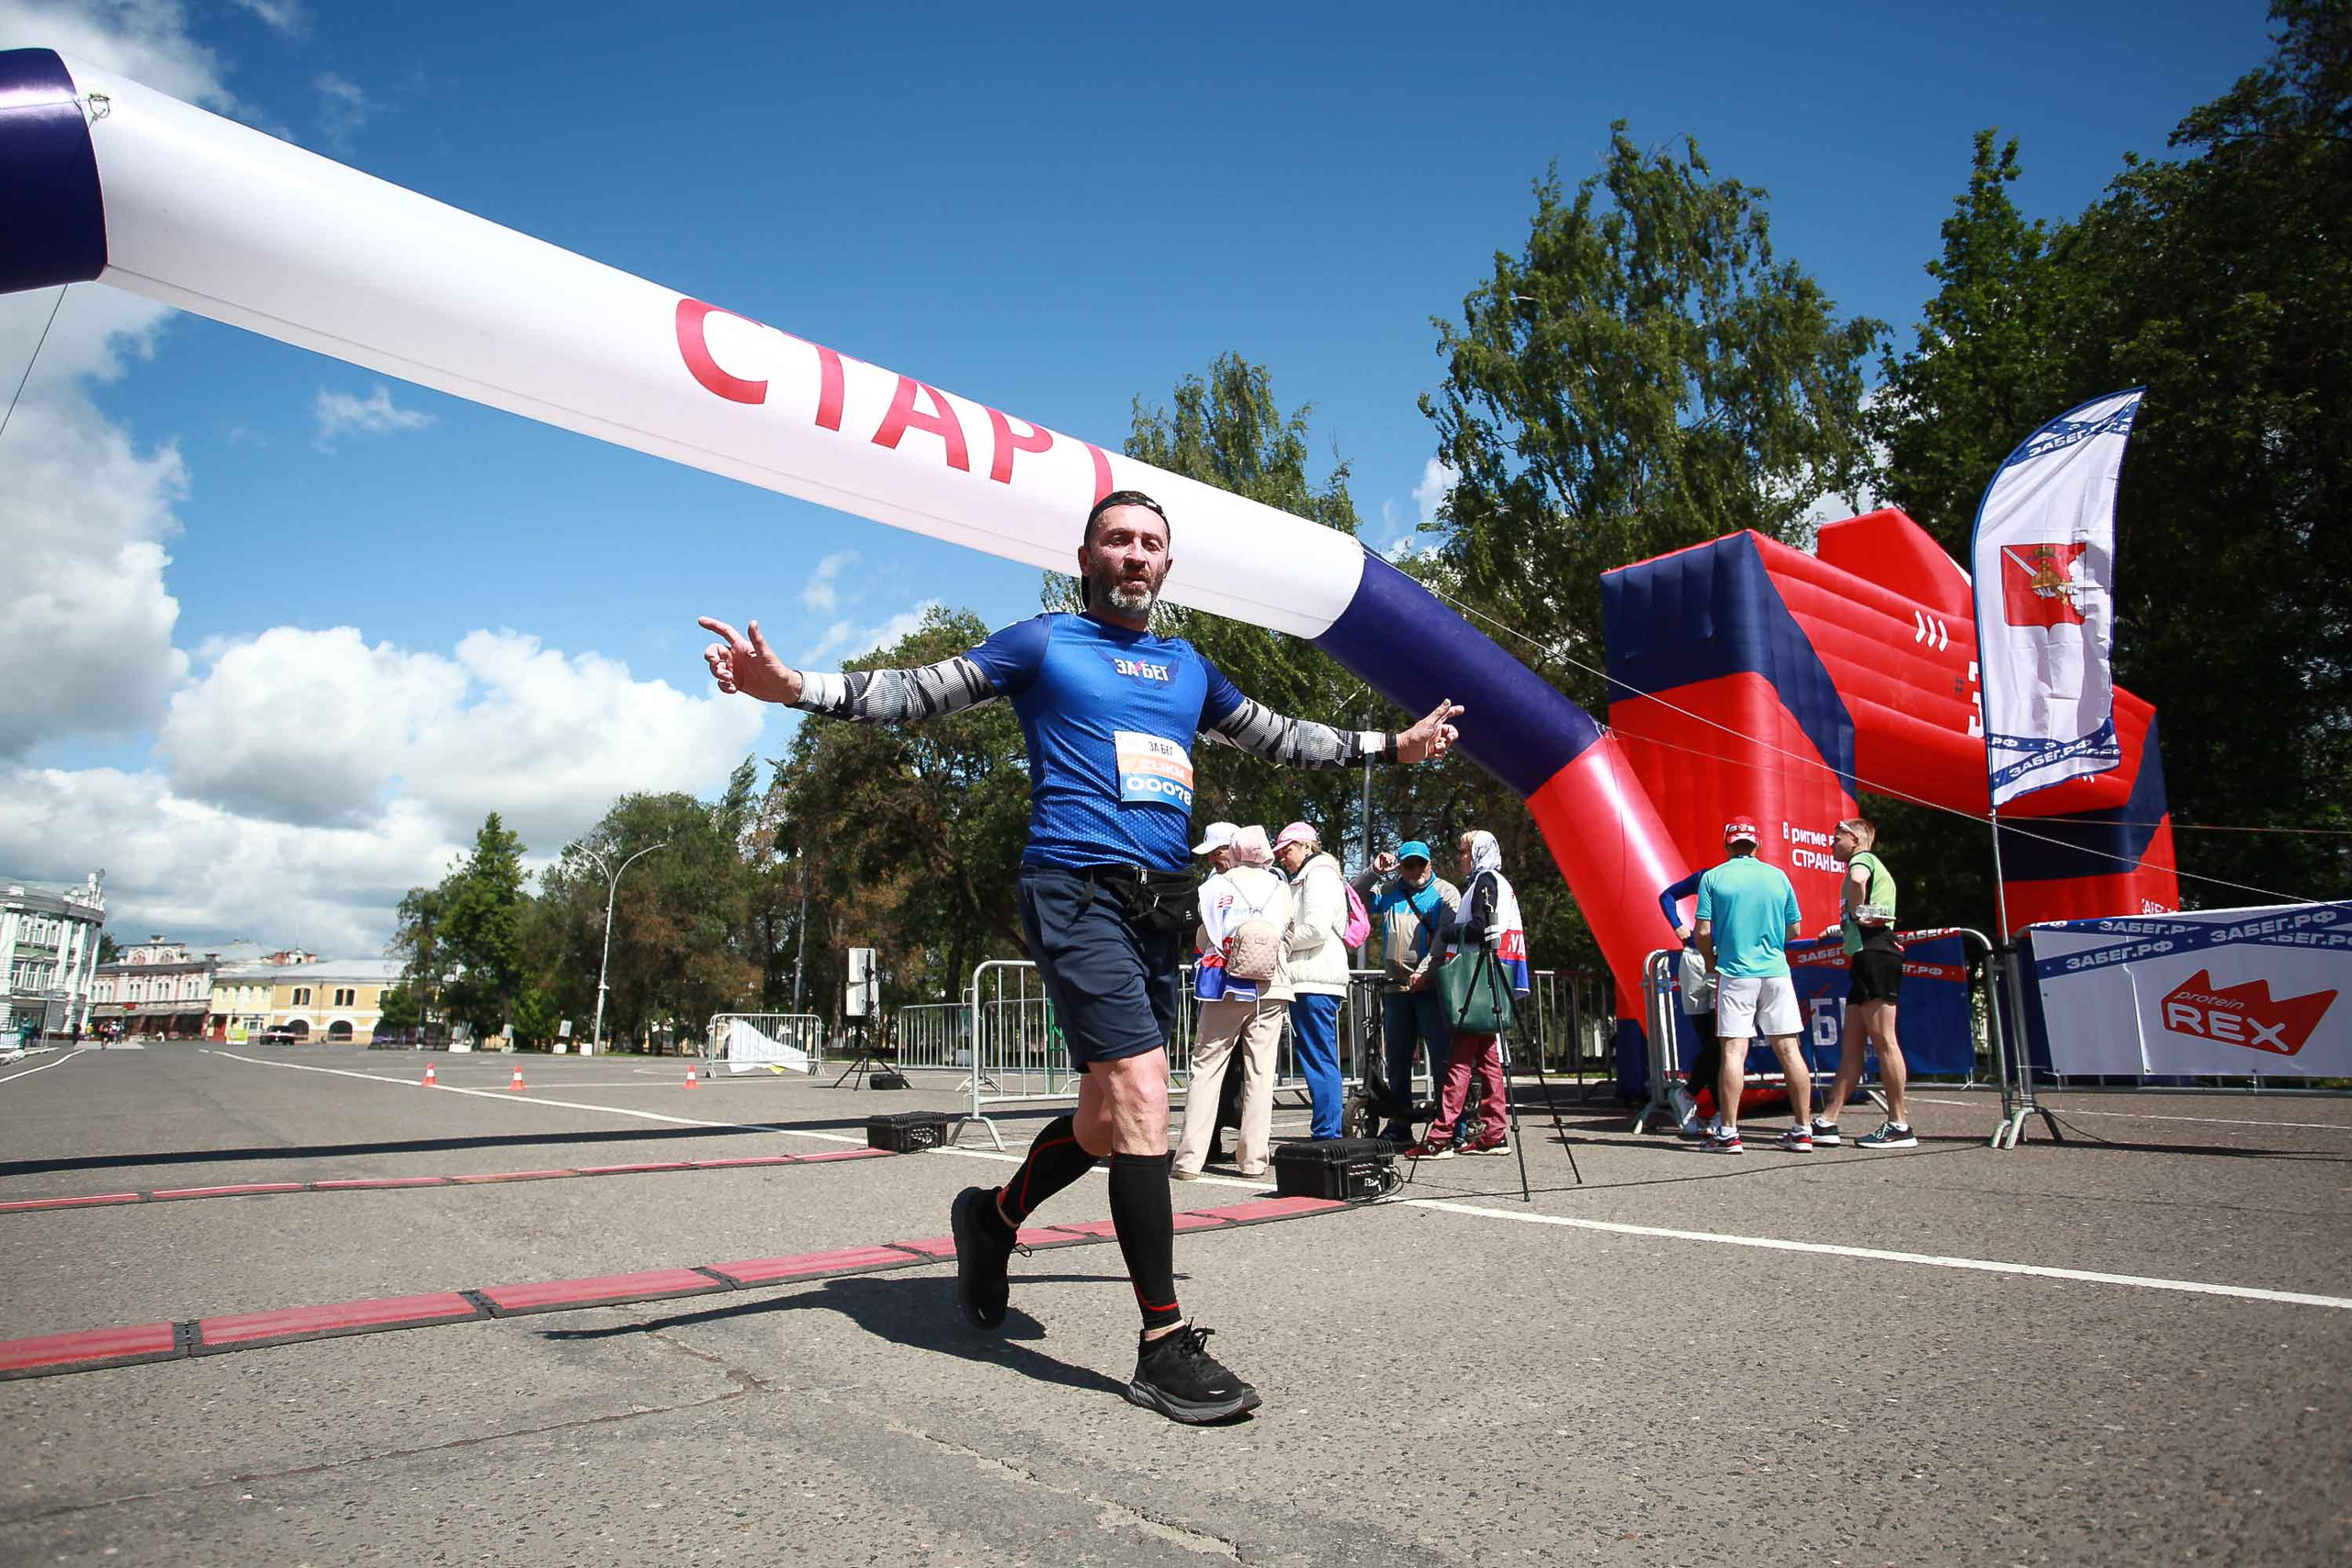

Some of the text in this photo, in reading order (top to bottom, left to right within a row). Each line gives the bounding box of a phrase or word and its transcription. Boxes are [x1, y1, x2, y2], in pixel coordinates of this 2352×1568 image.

[675, 298, 1113, 511] СТАРТ
[2008, 739, 2093, 777] ЗАБЕГ.РФ
[1126, 777, 1192, 807] 00078
[1782, 821, 1789, 840] В
[1792, 828, 1827, 847] ритме
[1792, 848, 1845, 874] СТРАНЫ!
[2098, 920, 2202, 935] ЗАБЕГ.Р
[2210, 910, 2337, 943] ЗАБЕГ.РФ
[1797, 945, 1845, 964] ЗАБЕГ
[2066, 940, 2174, 970] ЗАБЕГ.РФ
[2175, 991, 2245, 1010] protein
[2167, 1002, 2290, 1052] REX
